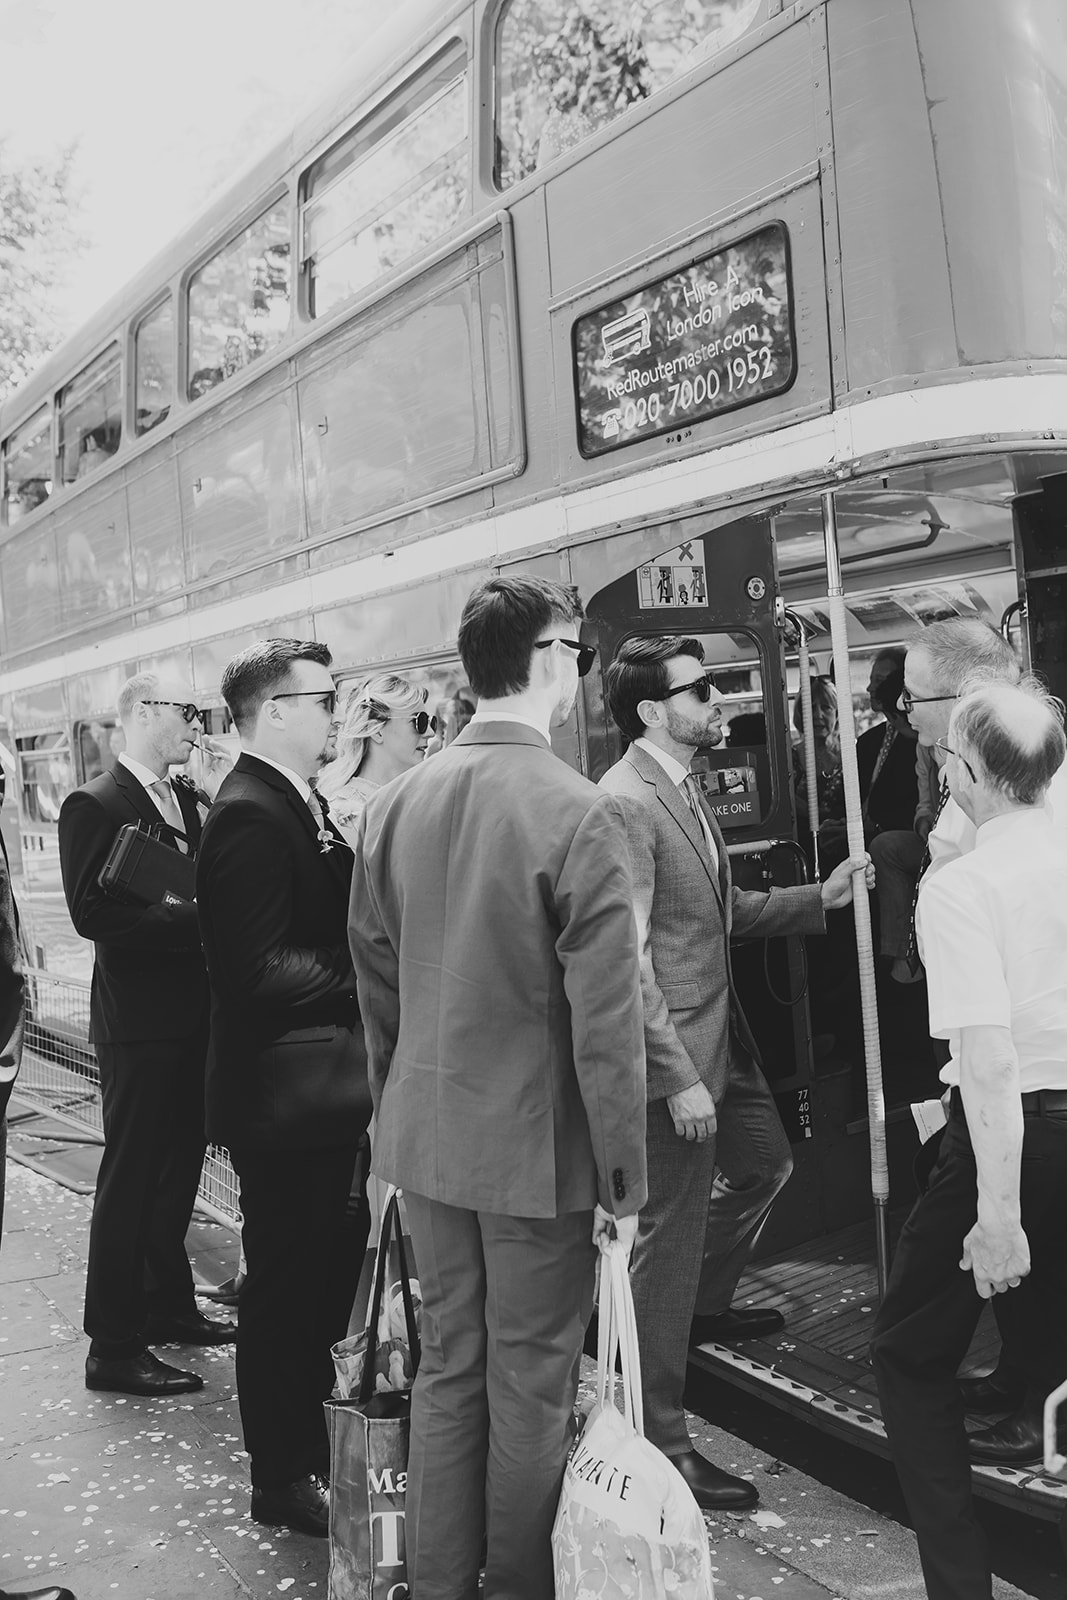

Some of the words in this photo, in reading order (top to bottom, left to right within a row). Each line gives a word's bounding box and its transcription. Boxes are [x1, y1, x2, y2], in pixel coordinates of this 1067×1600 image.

[683, 280, 718, 307] Hire
[726, 265, 740, 290] A
[666, 303, 722, 341] London
[728, 287, 763, 314] Icon
[606, 324, 758, 400] RedRoutemaster.com
[624, 393, 660, 430] 020
[667, 369, 720, 416] 7000
[727, 346, 773, 392] 1952
[730, 801, 752, 814] ONE
[798, 1089, 808, 1100] 77
[798, 1102, 809, 1112] 40
